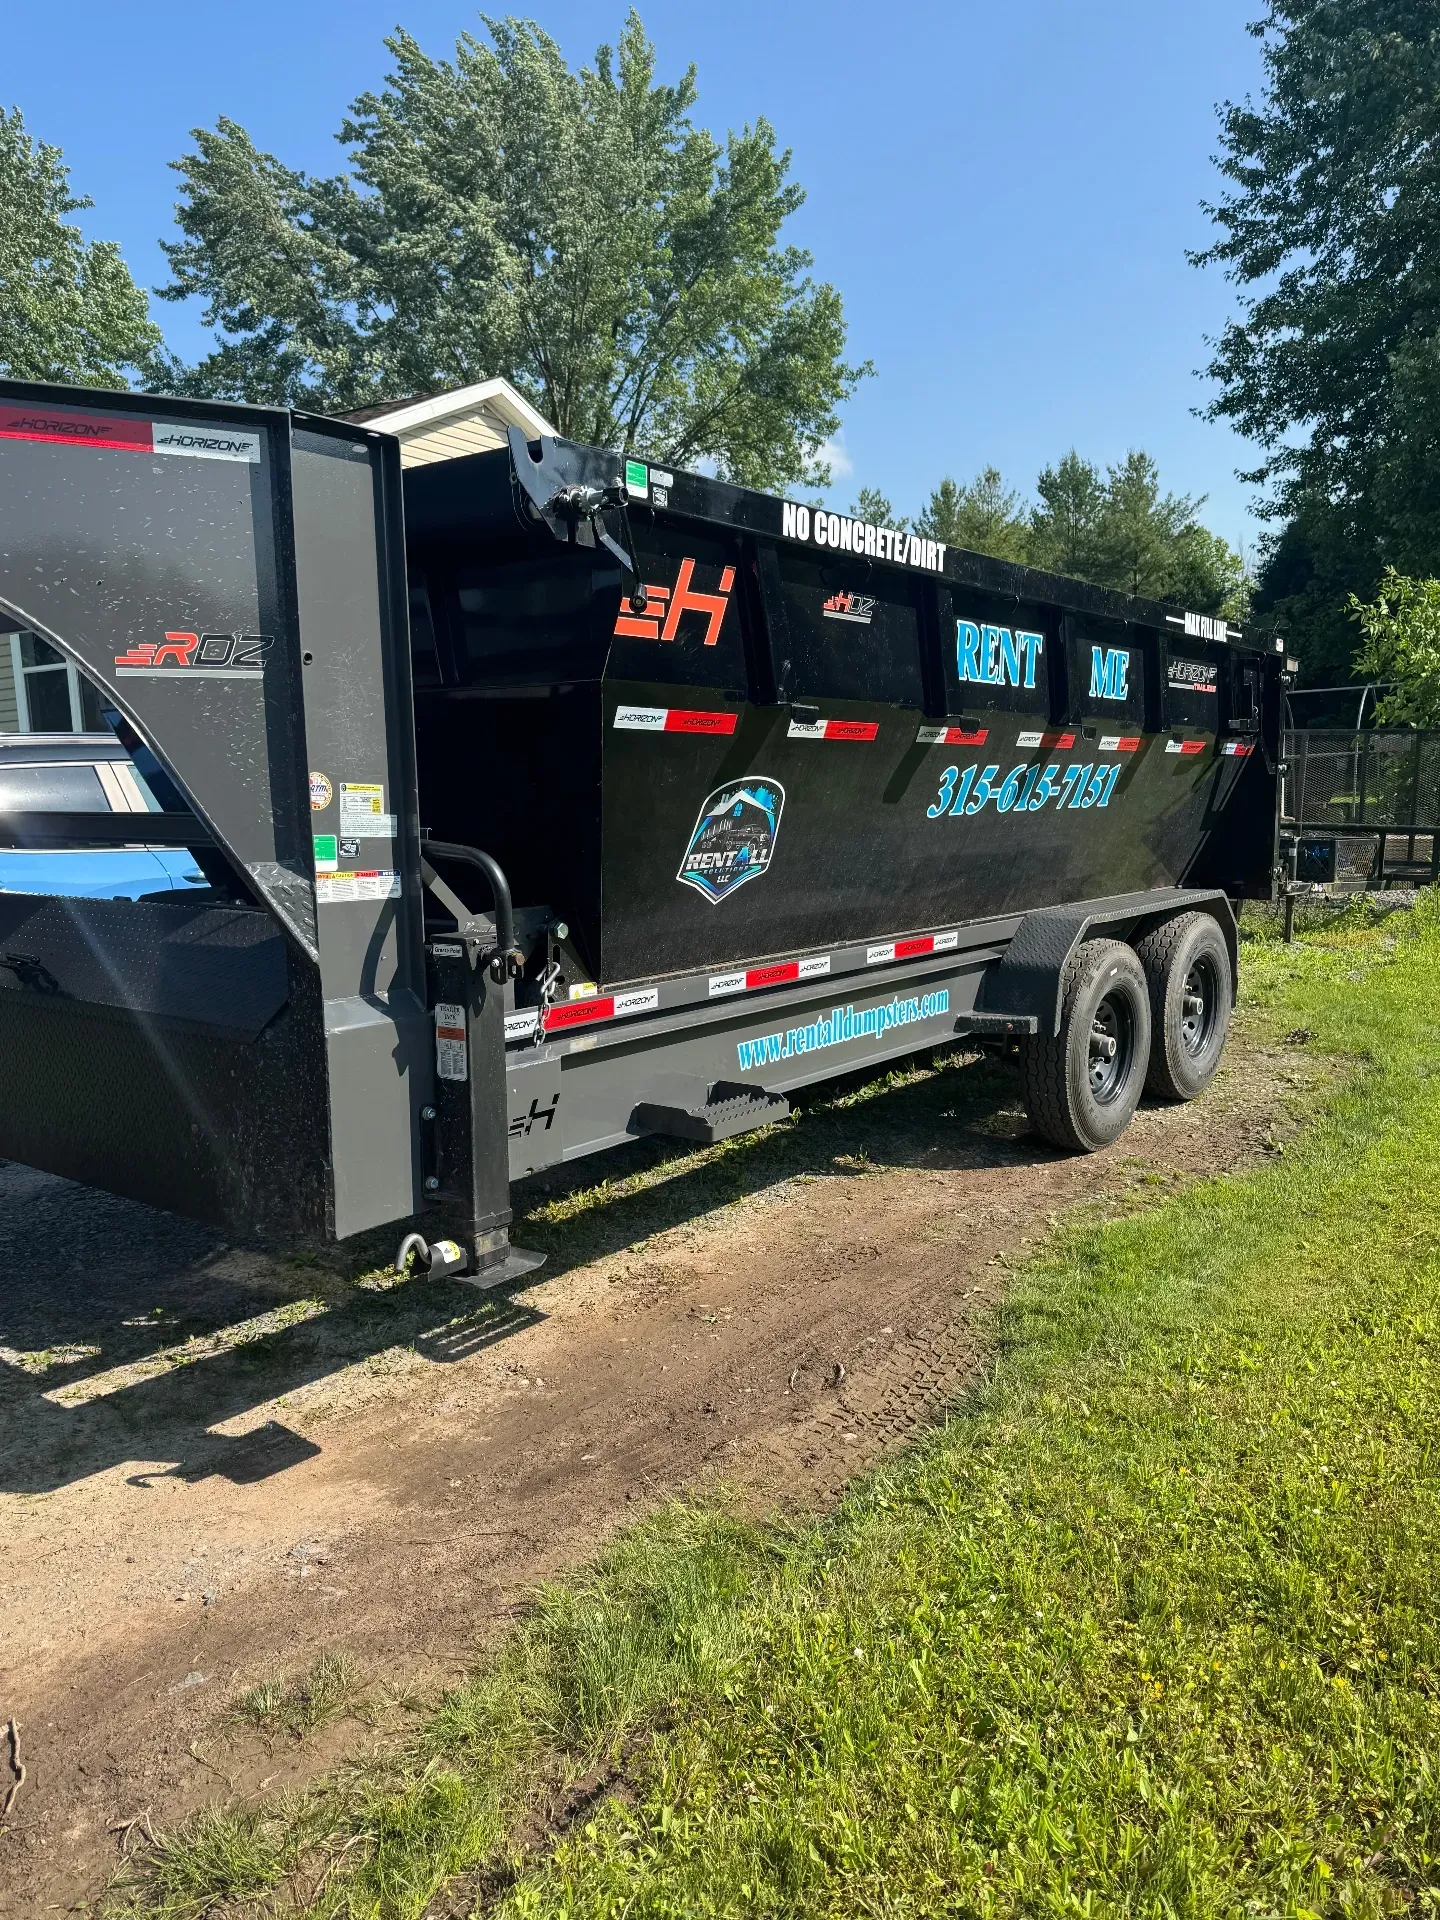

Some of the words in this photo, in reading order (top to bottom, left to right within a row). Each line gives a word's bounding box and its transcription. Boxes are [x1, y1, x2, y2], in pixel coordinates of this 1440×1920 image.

[16, 416, 106, 437] HORIZON
[164, 433, 246, 453] HORIZON
[782, 502, 810, 541] NO
[814, 510, 948, 573] CONCRETE/DIRT
[1184, 611, 1201, 637] MAX
[1200, 615, 1213, 640] FILL
[1213, 619, 1228, 643] LINE
[956, 619, 1044, 689] RENT
[1088, 645, 1130, 700] ME
[621, 713, 659, 723] HORIZON
[684, 717, 718, 727] HORIZON
[926, 762, 1122, 819] 315-615-7151
[685, 846, 770, 870] RENTALL
[716, 874, 731, 884] LLC
[560, 1007, 596, 1020] HORIZON
[620, 996, 652, 1009] HORIZON
[736, 989, 950, 1072] www.rentalldumpsters.com
